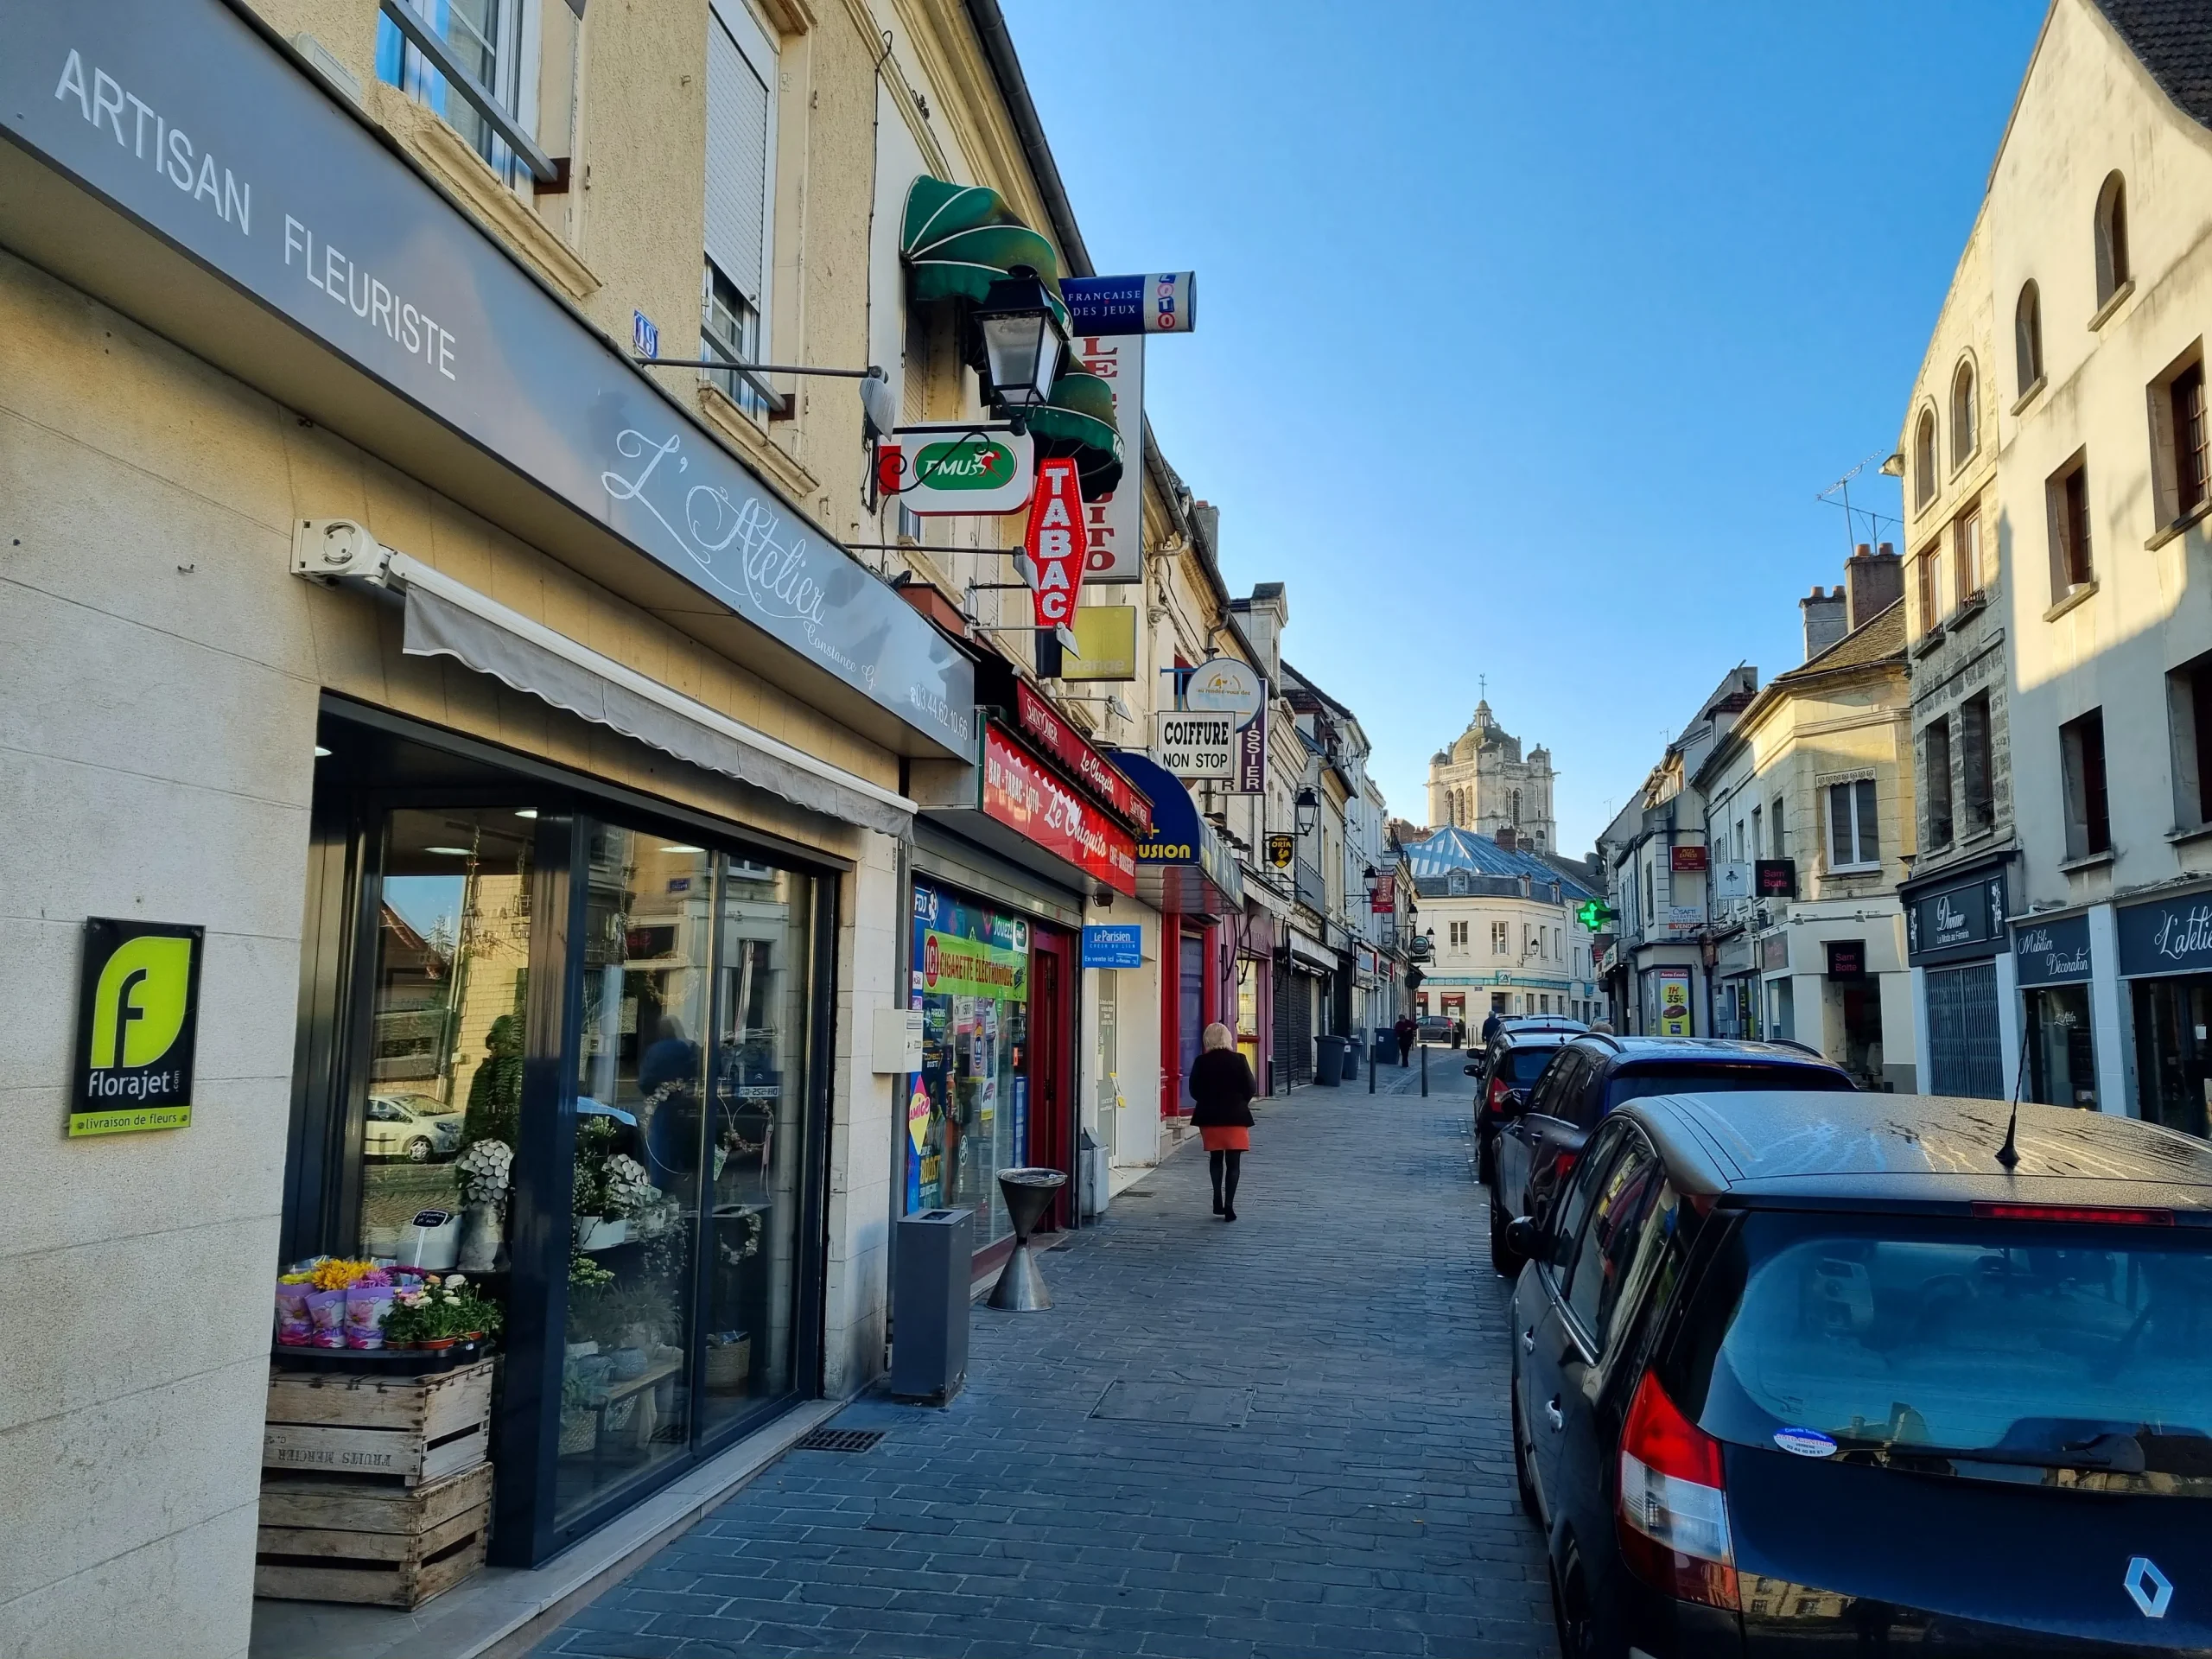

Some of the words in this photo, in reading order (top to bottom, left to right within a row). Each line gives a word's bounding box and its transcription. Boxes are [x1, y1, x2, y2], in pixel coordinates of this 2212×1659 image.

[54, 48, 251, 236] ARTISAN
[284, 213, 456, 381] FLEURISTE
[1073, 308, 1096, 316] DES
[1103, 305, 1135, 316] JEUX
[1157, 274, 1177, 329] LOTO
[925, 460, 972, 476] PMU
[601, 429, 827, 627] L'Atelier
[1039, 467, 1072, 619] TABAC
[804, 620, 857, 673] Constance
[1065, 660, 1125, 677] orange
[1164, 721, 1229, 746] COIFFURE
[1080, 750, 1090, 772] Le
[1163, 753, 1190, 767] NON
[1196, 753, 1228, 768] STOP
[988, 758, 1001, 790] BAR
[1005, 768, 1023, 804] TABAC
[1026, 785, 1040, 815] LOTO
[1044, 791, 1063, 830] Le
[1065, 803, 1107, 860] Chiquito
[914, 893, 927, 912] FDJ
[995, 915, 1013, 940] Jouez!
[1094, 933, 1102, 942] Le
[1103, 930, 1130, 942] Parisien
[2018, 929, 2053, 955] Mobilier
[926, 945, 938, 975] ICI
[939, 951, 973, 982] CIGARETTE
[1666, 995, 1684, 1004] 35€
[88, 1071, 171, 1100] florajet
[173, 1071, 181, 1092] .com
[909, 1096, 931, 1121] AMIGO
[86, 1116, 130, 1129] livraison
[133, 1115, 146, 1125] de
[149, 1114, 177, 1124] fleurs
[278, 1448, 334, 1465] MERCIER
[342, 1452, 391, 1466] FRUITS
